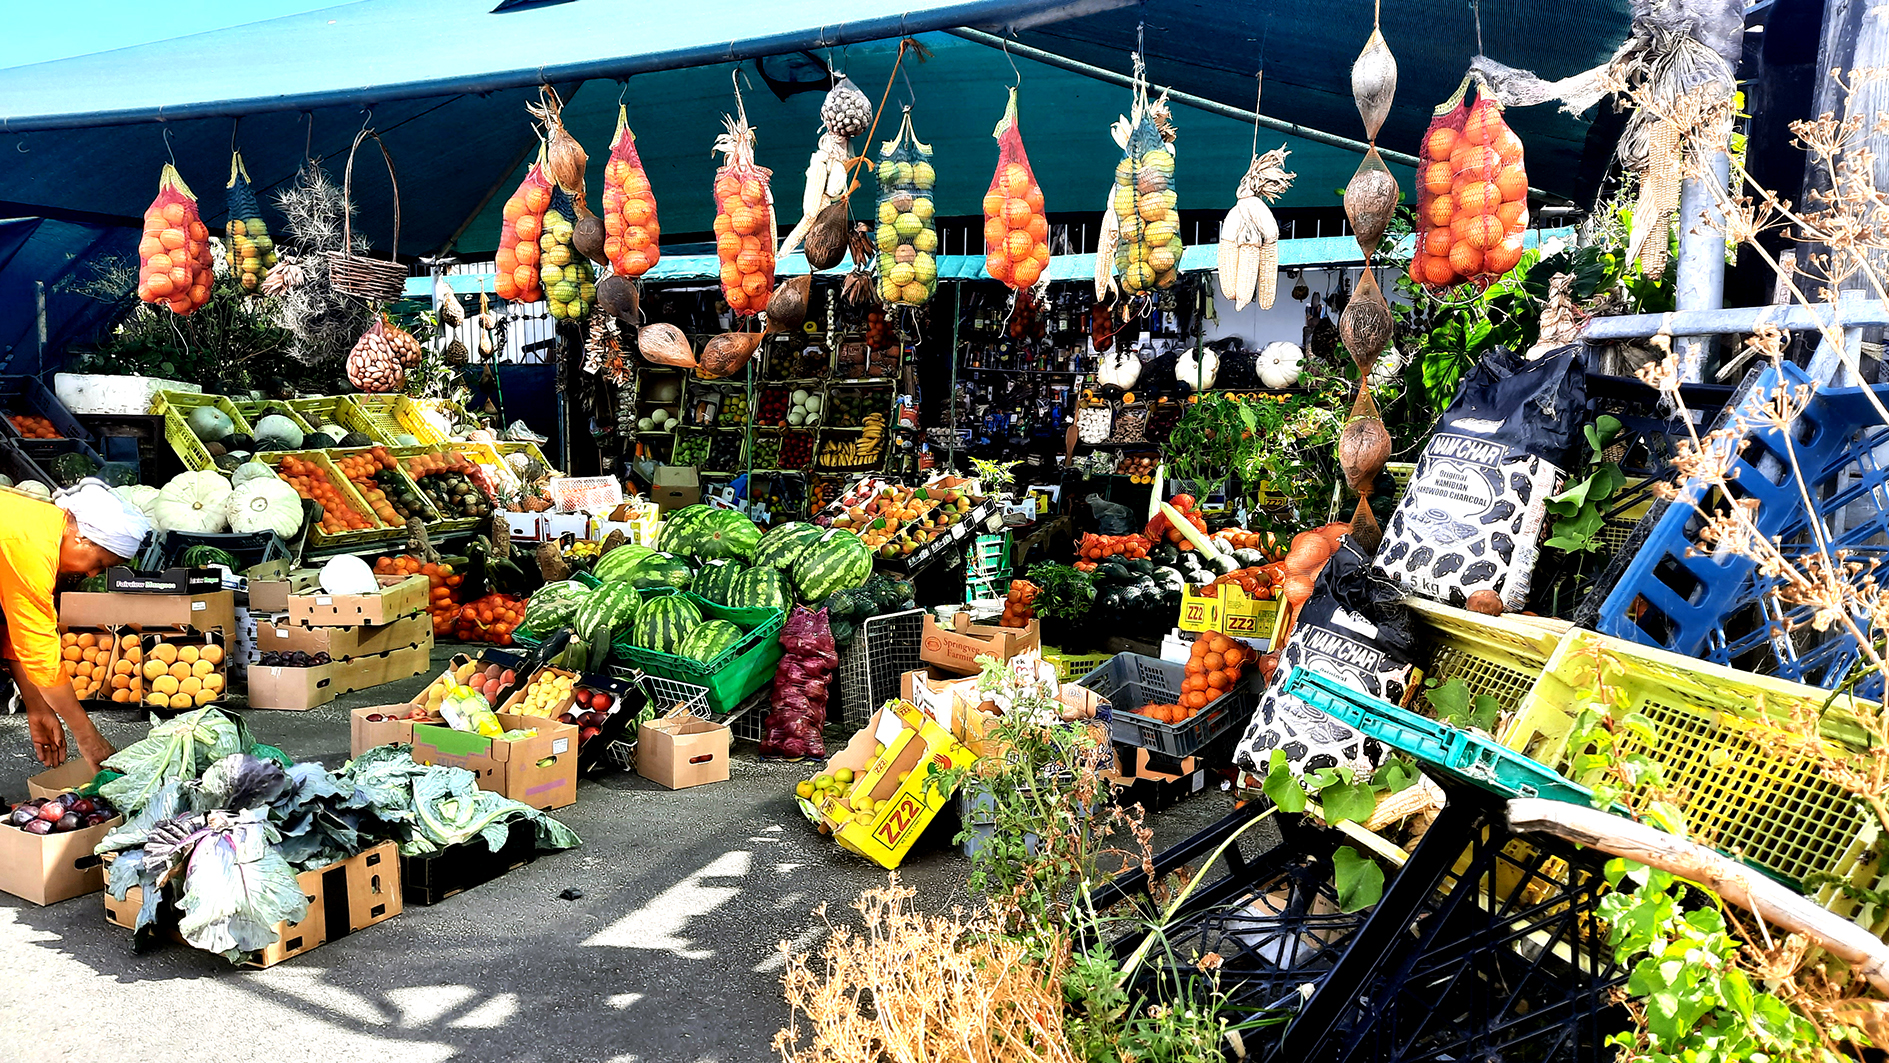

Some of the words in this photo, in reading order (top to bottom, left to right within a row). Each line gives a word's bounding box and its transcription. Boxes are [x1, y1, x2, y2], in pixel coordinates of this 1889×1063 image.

[1439, 470, 1468, 482] Original
[1434, 479, 1469, 492] NAMIBIAN
[1416, 485, 1449, 498] HARDWOOD
[1449, 491, 1487, 507] CHARCOAL
[1410, 575, 1418, 587] 5
[1422, 578, 1440, 595] kg
[1189, 606, 1203, 620] ZZ2
[1229, 617, 1255, 630] ZZ2
[943, 637, 981, 653] Springveg
[947, 648, 978, 664] Farmin
[874, 760, 888, 774] ZZ2
[879, 799, 921, 845] ZZ2
